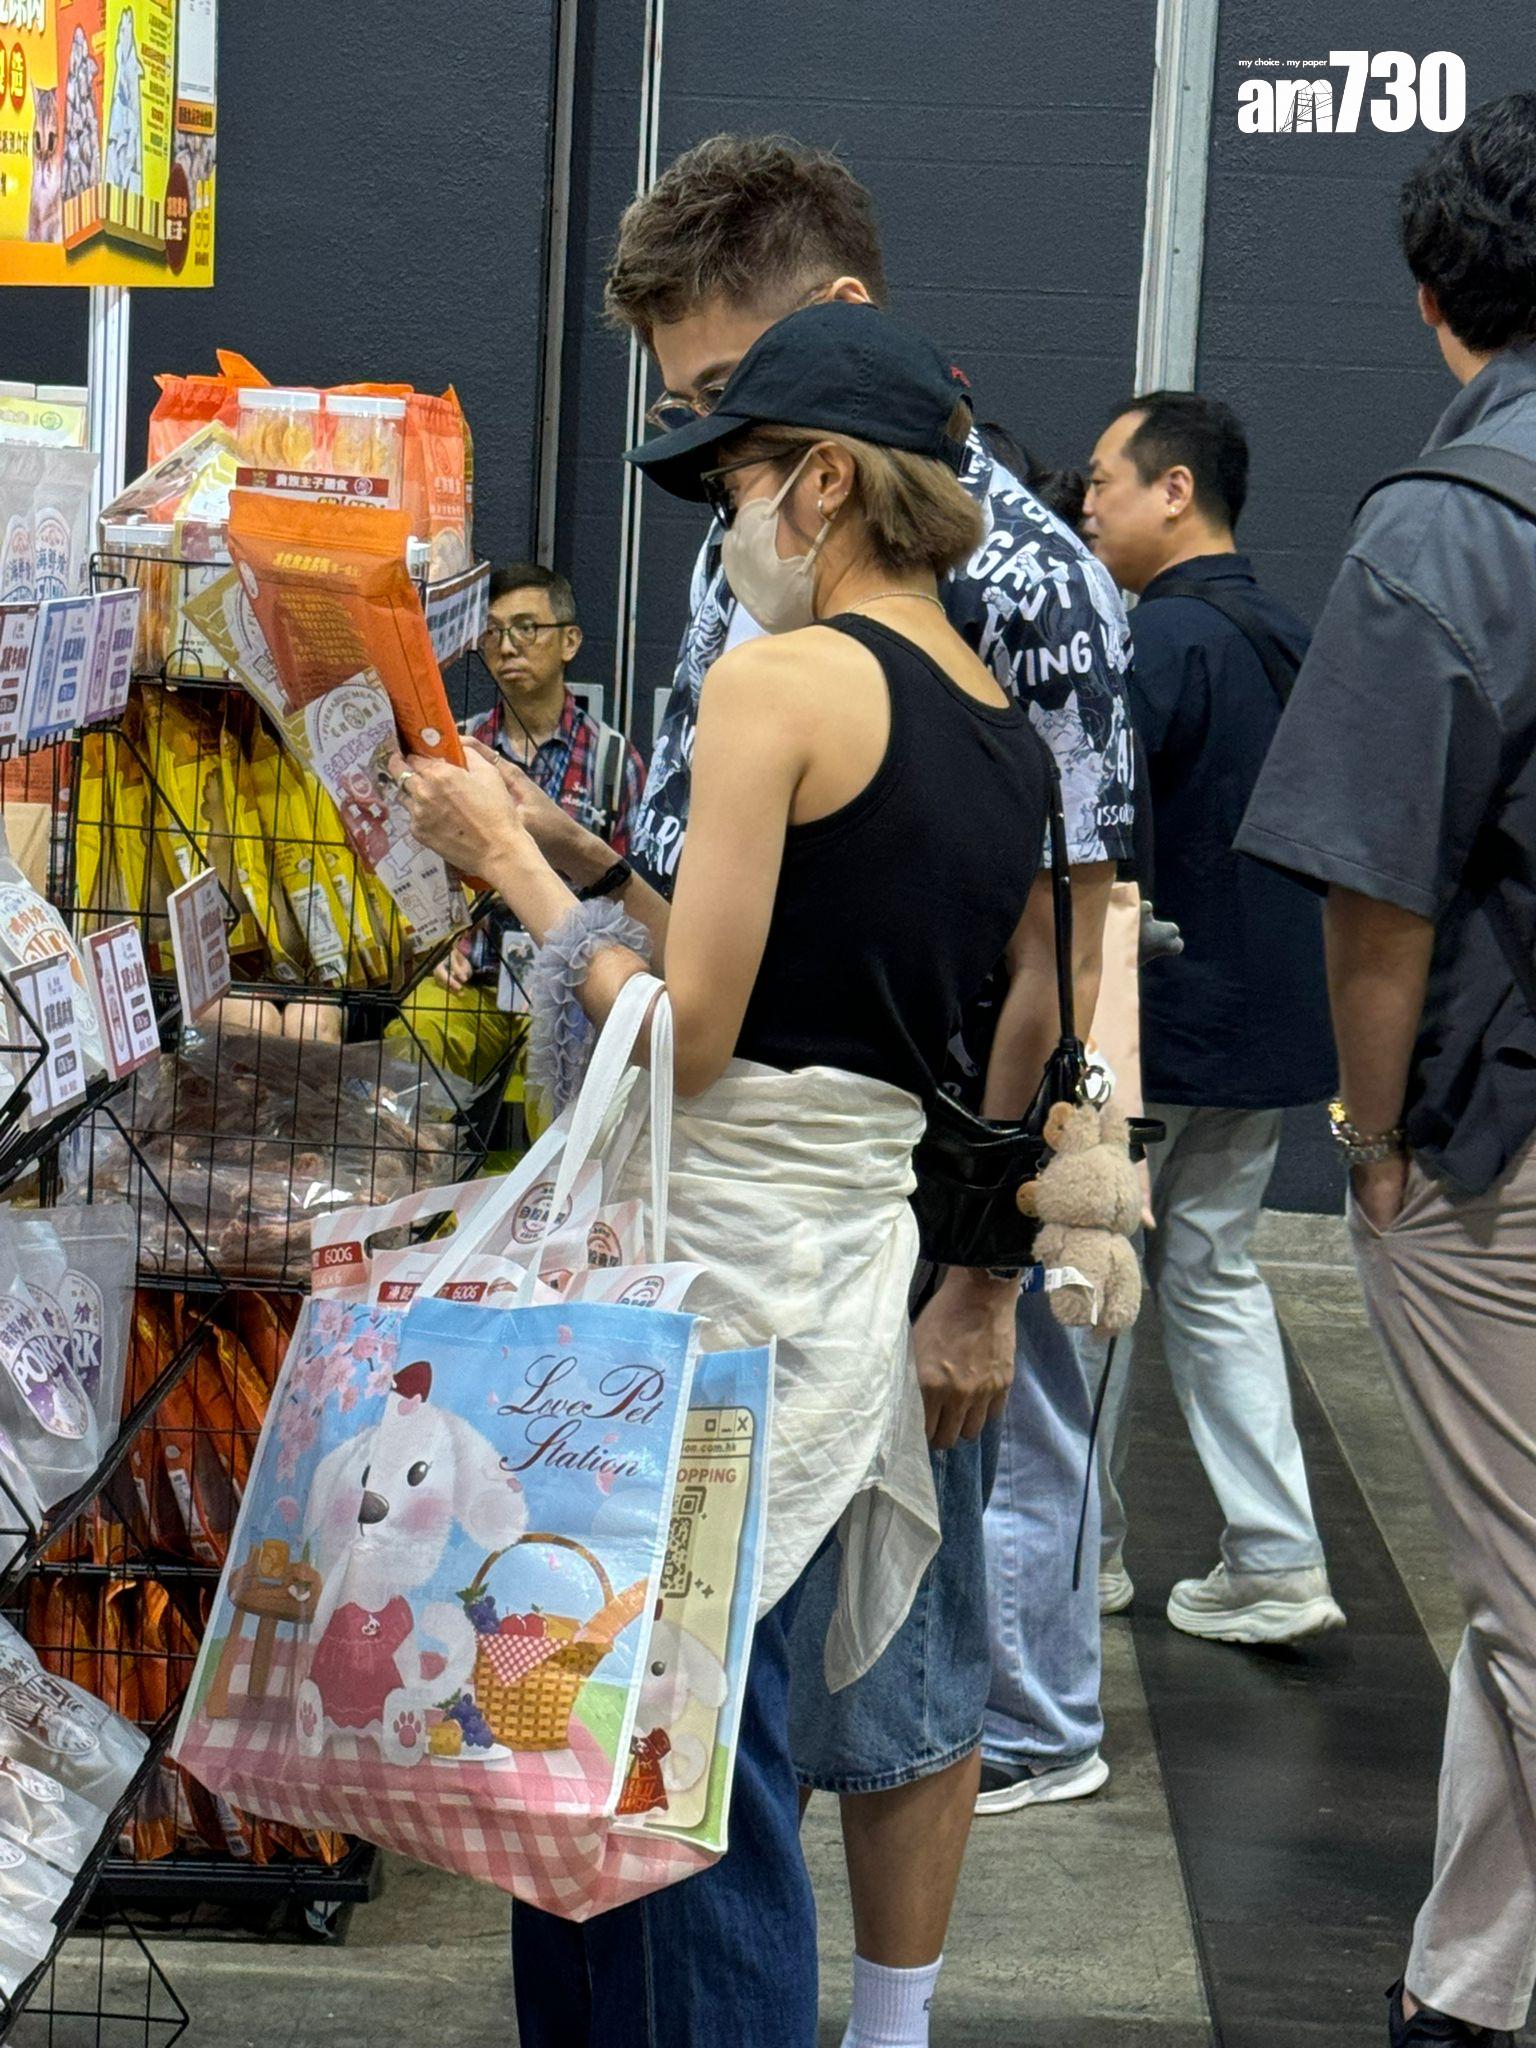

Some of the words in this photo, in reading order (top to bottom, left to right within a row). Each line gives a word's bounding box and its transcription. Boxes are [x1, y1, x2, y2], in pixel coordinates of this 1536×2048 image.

[324, 1246, 353, 1265] 600G
[498, 1354, 588, 1417] Love
[584, 1364, 665, 1425] Pet
[499, 1414, 640, 1477] Station
